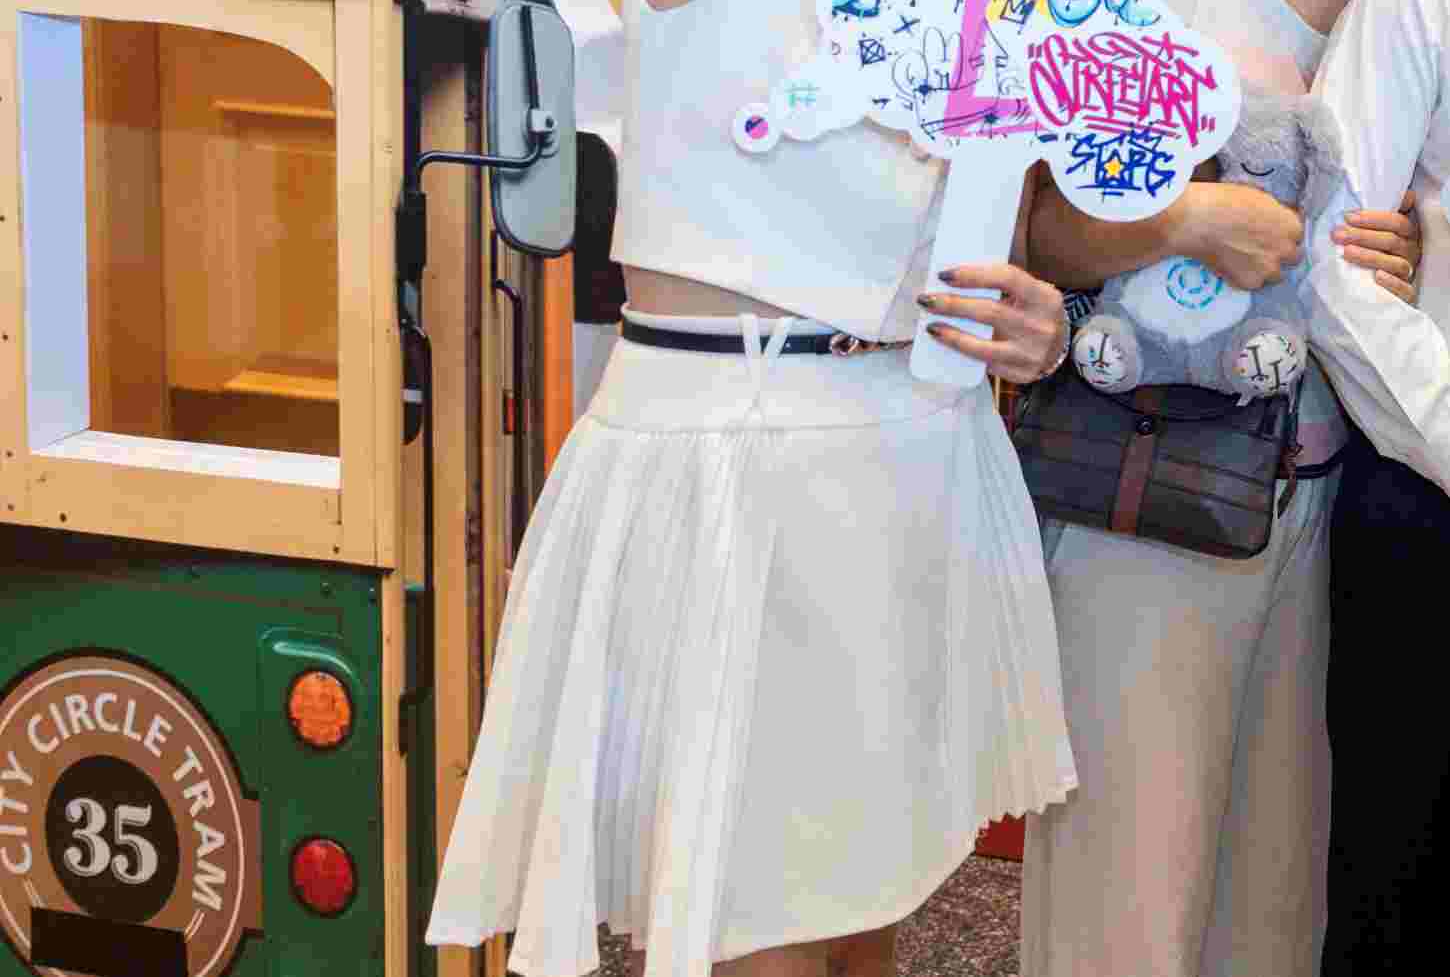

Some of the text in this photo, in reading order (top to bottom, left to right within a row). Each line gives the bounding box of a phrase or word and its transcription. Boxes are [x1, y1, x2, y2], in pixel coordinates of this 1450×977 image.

[0, 692, 227, 911] CITY CIRCLE TRAM
[63, 797, 159, 885] 35
